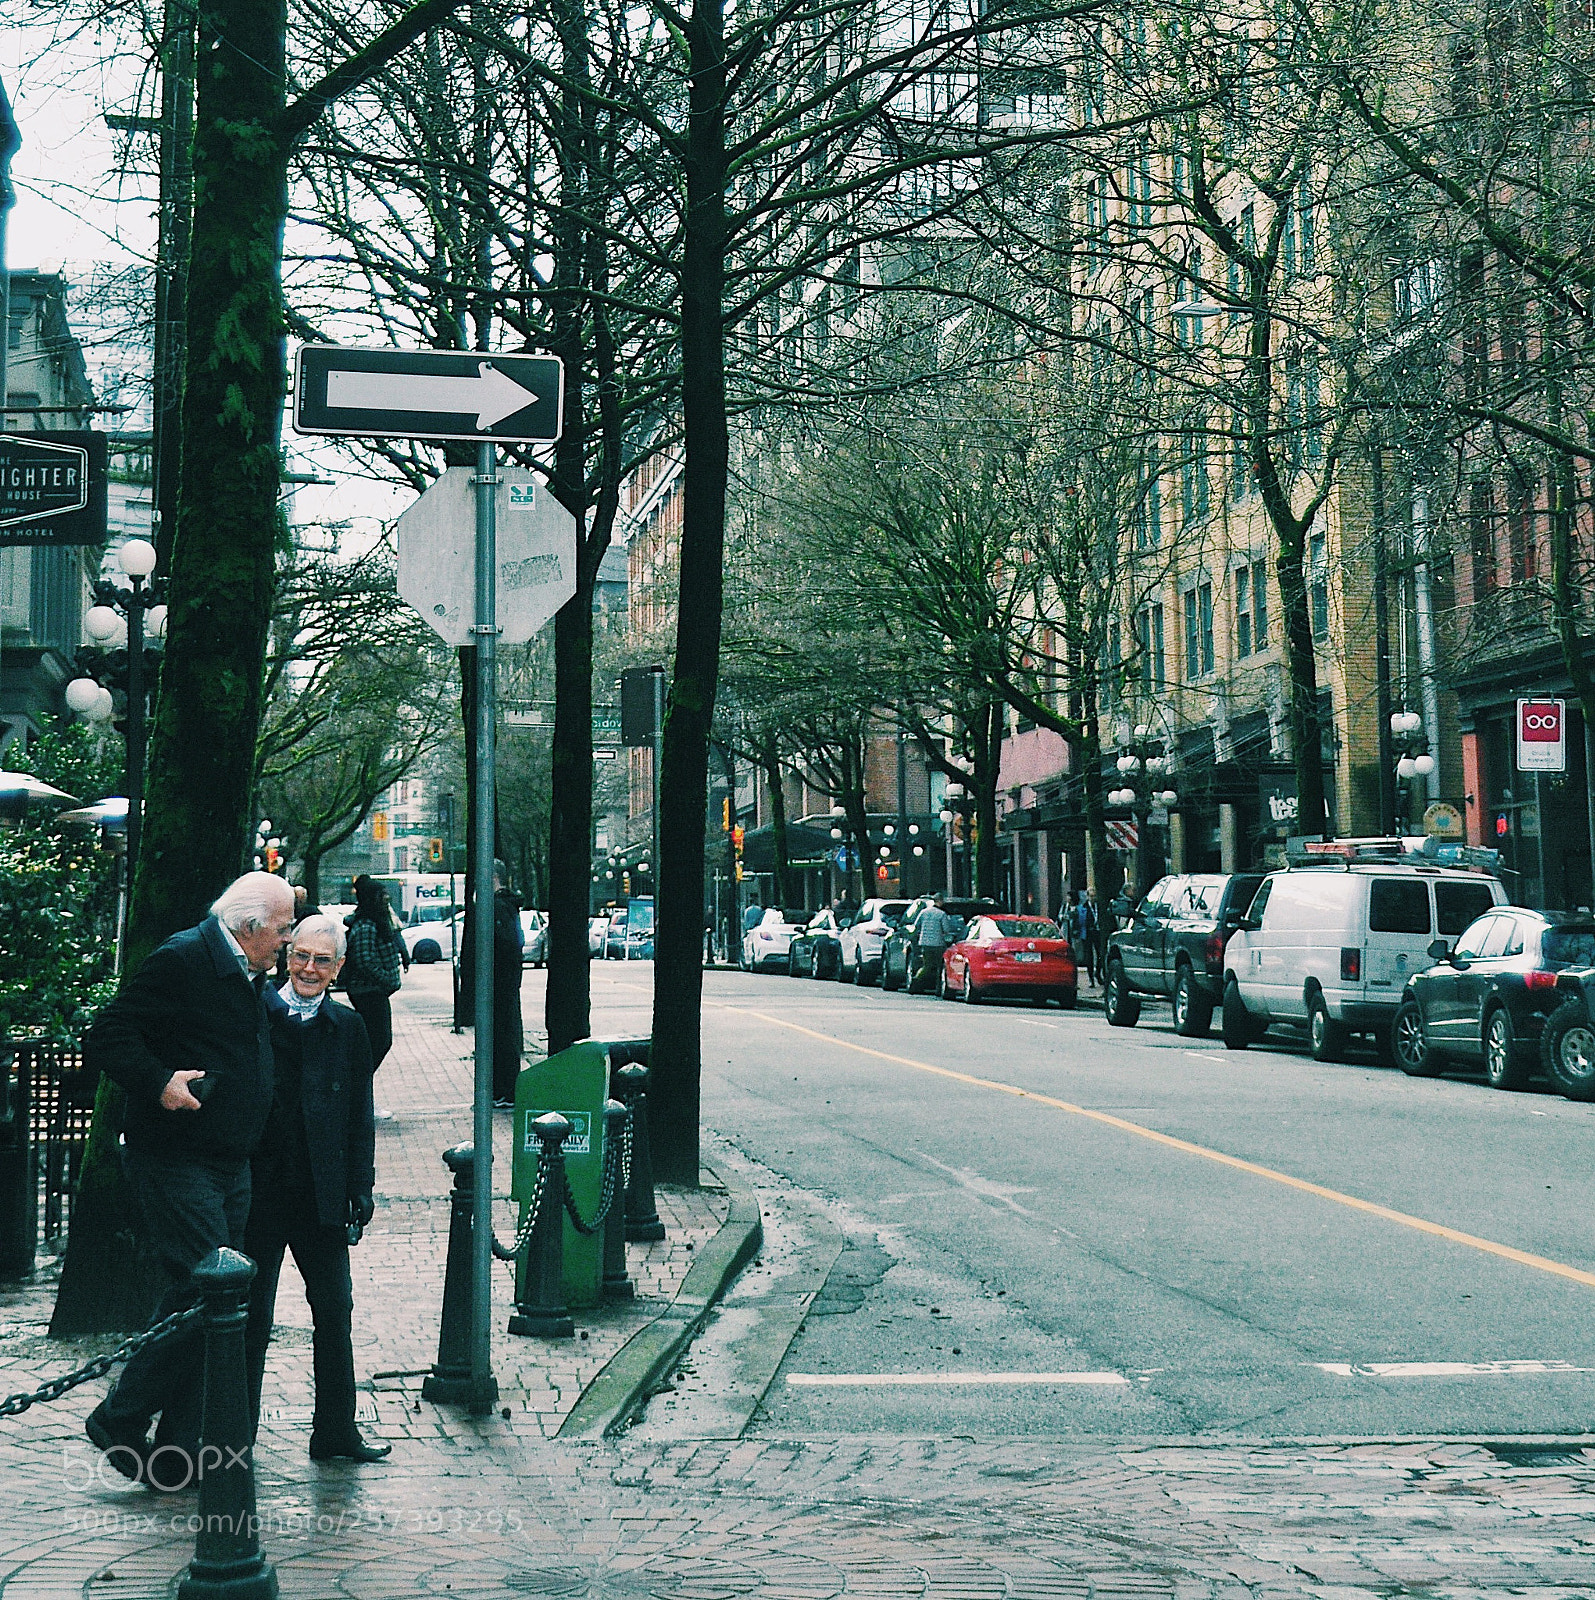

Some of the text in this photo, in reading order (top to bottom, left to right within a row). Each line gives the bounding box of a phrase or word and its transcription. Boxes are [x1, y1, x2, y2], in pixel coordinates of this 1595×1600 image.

[0, 467, 78, 487] IGHTER
[7, 490, 41, 500] HOUSE
[16, 528, 54, 536] HOTEL
[562, 1134, 586, 1146] AILY
